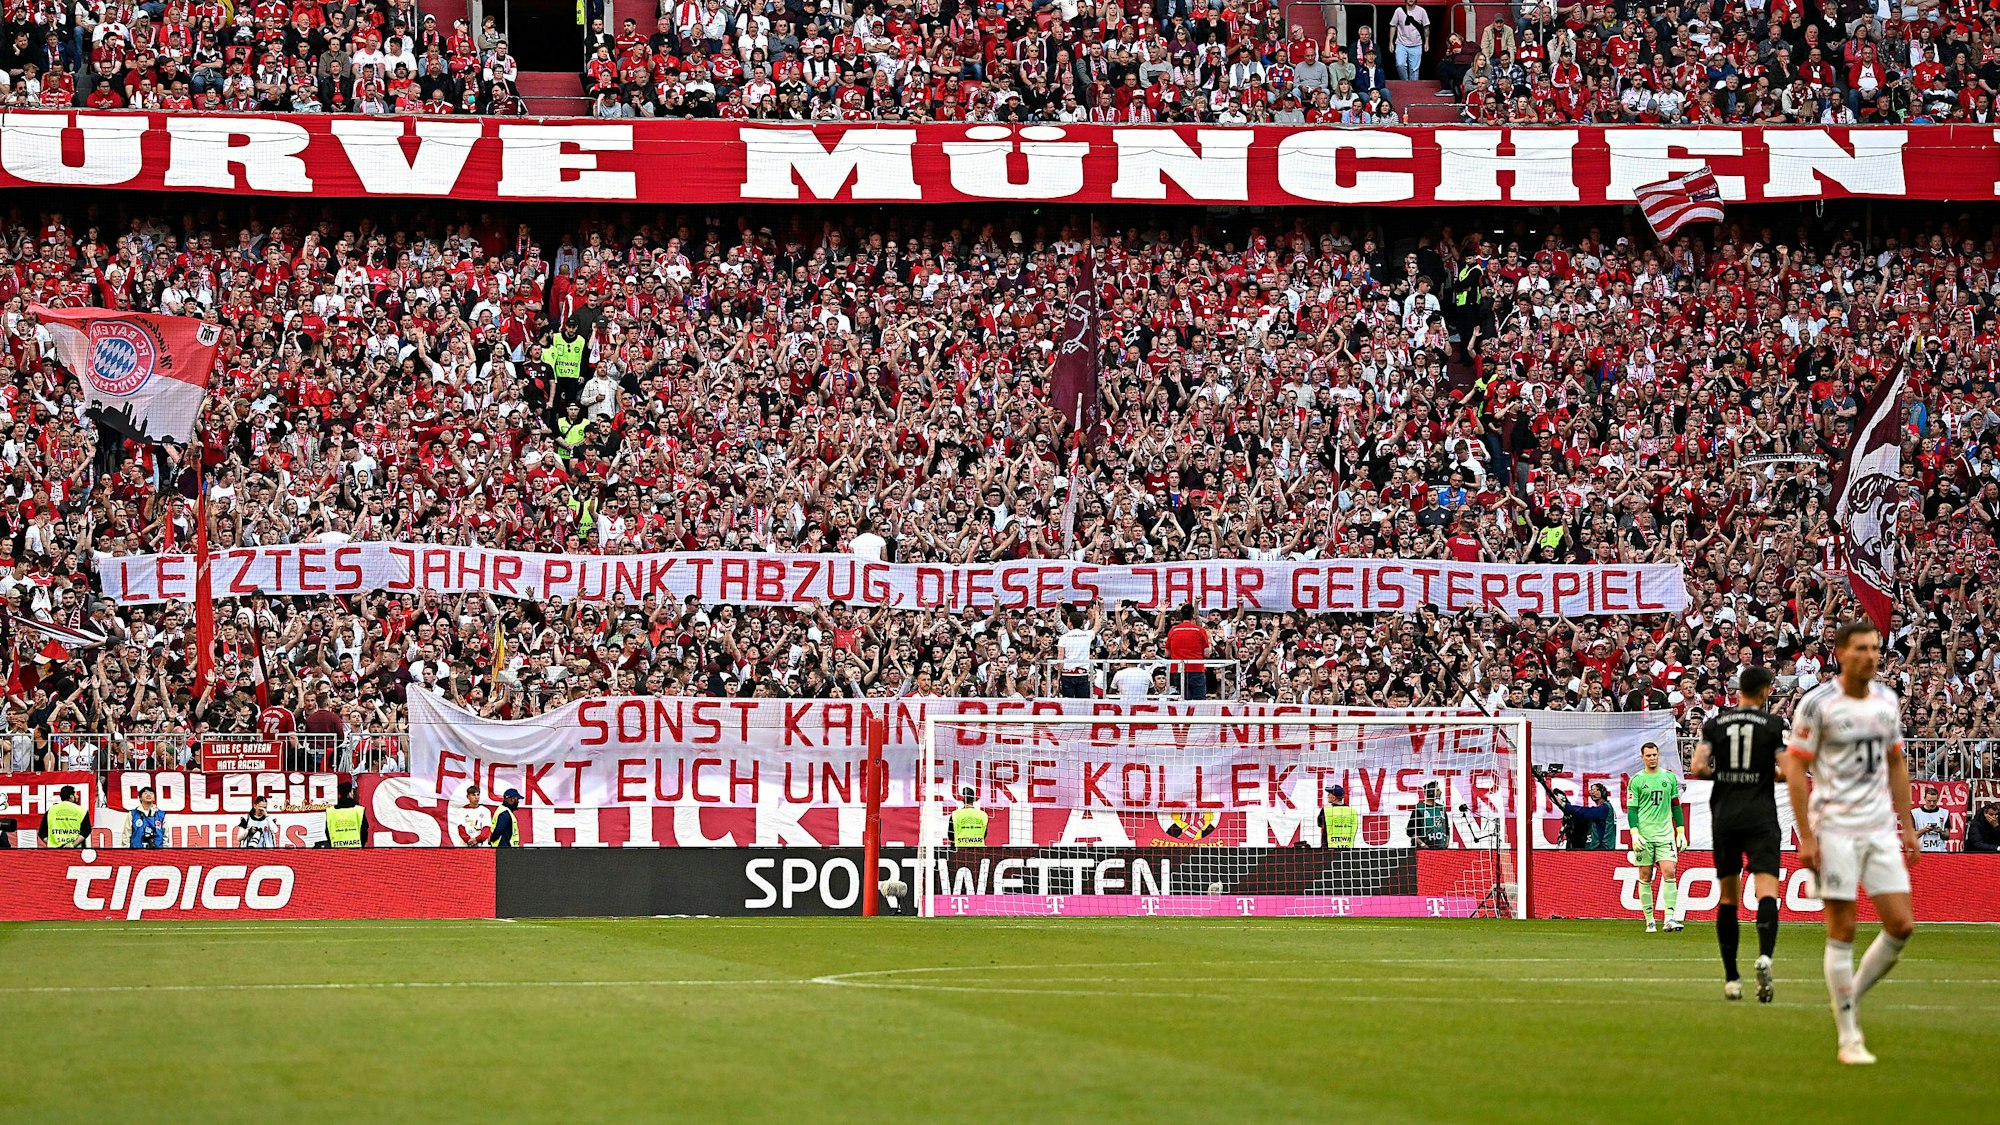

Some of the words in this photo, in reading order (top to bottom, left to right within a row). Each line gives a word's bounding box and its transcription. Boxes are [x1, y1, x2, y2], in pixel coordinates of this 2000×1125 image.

[739, 125, 1908, 203] MÜNCHEN
[121, 547, 363, 600] LEZTES
[389, 546, 524, 590] JAHR
[916, 566, 1101, 610] DIESES
[1131, 567, 1265, 609] JAHR
[1291, 566, 1665, 614] GEISTERSPIEL
[212, 744, 231, 754] LOVE
[232, 744, 242, 754] FC
[243, 743, 272, 754] BAYERN
[578, 700, 759, 746] SONST
[784, 702, 926, 746] KANN
[955, 701, 1065, 746] DER
[1219, 705, 1370, 753] NICHT
[1726, 723, 1754, 770] 11
[217, 760, 236, 770] HATE
[237, 760, 266, 770] RACISM
[435, 750, 593, 806] FICKT
[617, 758, 759, 804] EUCH
[784, 760, 889, 804] UND
[915, 759, 1057, 804] EURE
[66, 849, 296, 921] tipico
